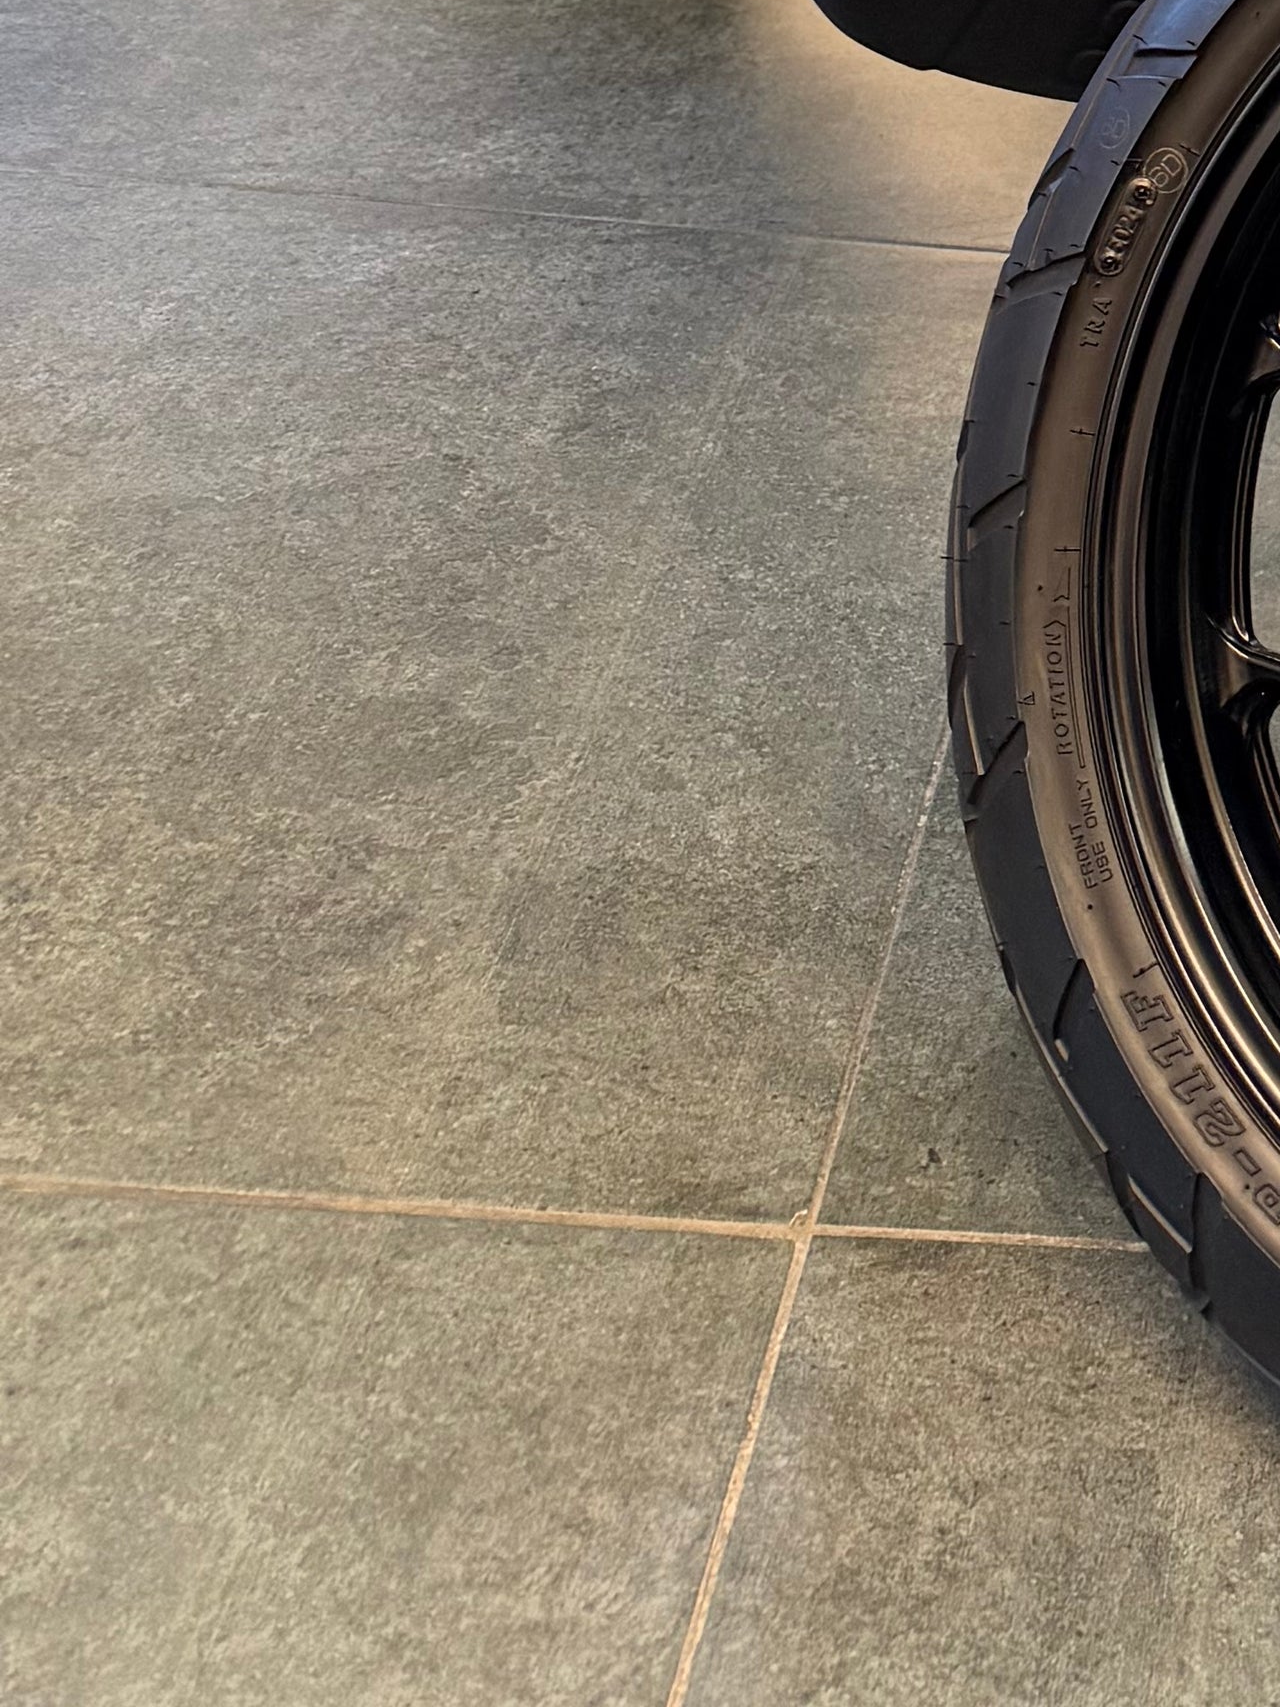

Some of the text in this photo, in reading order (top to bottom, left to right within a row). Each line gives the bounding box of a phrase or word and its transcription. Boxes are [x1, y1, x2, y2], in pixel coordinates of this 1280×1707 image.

[1079, 297, 1112, 348] TRA
[1046, 630, 1074, 756] ROTATION
[1068, 822, 1099, 889] FRONT
[1076, 779, 1114, 884] USE ONLY
